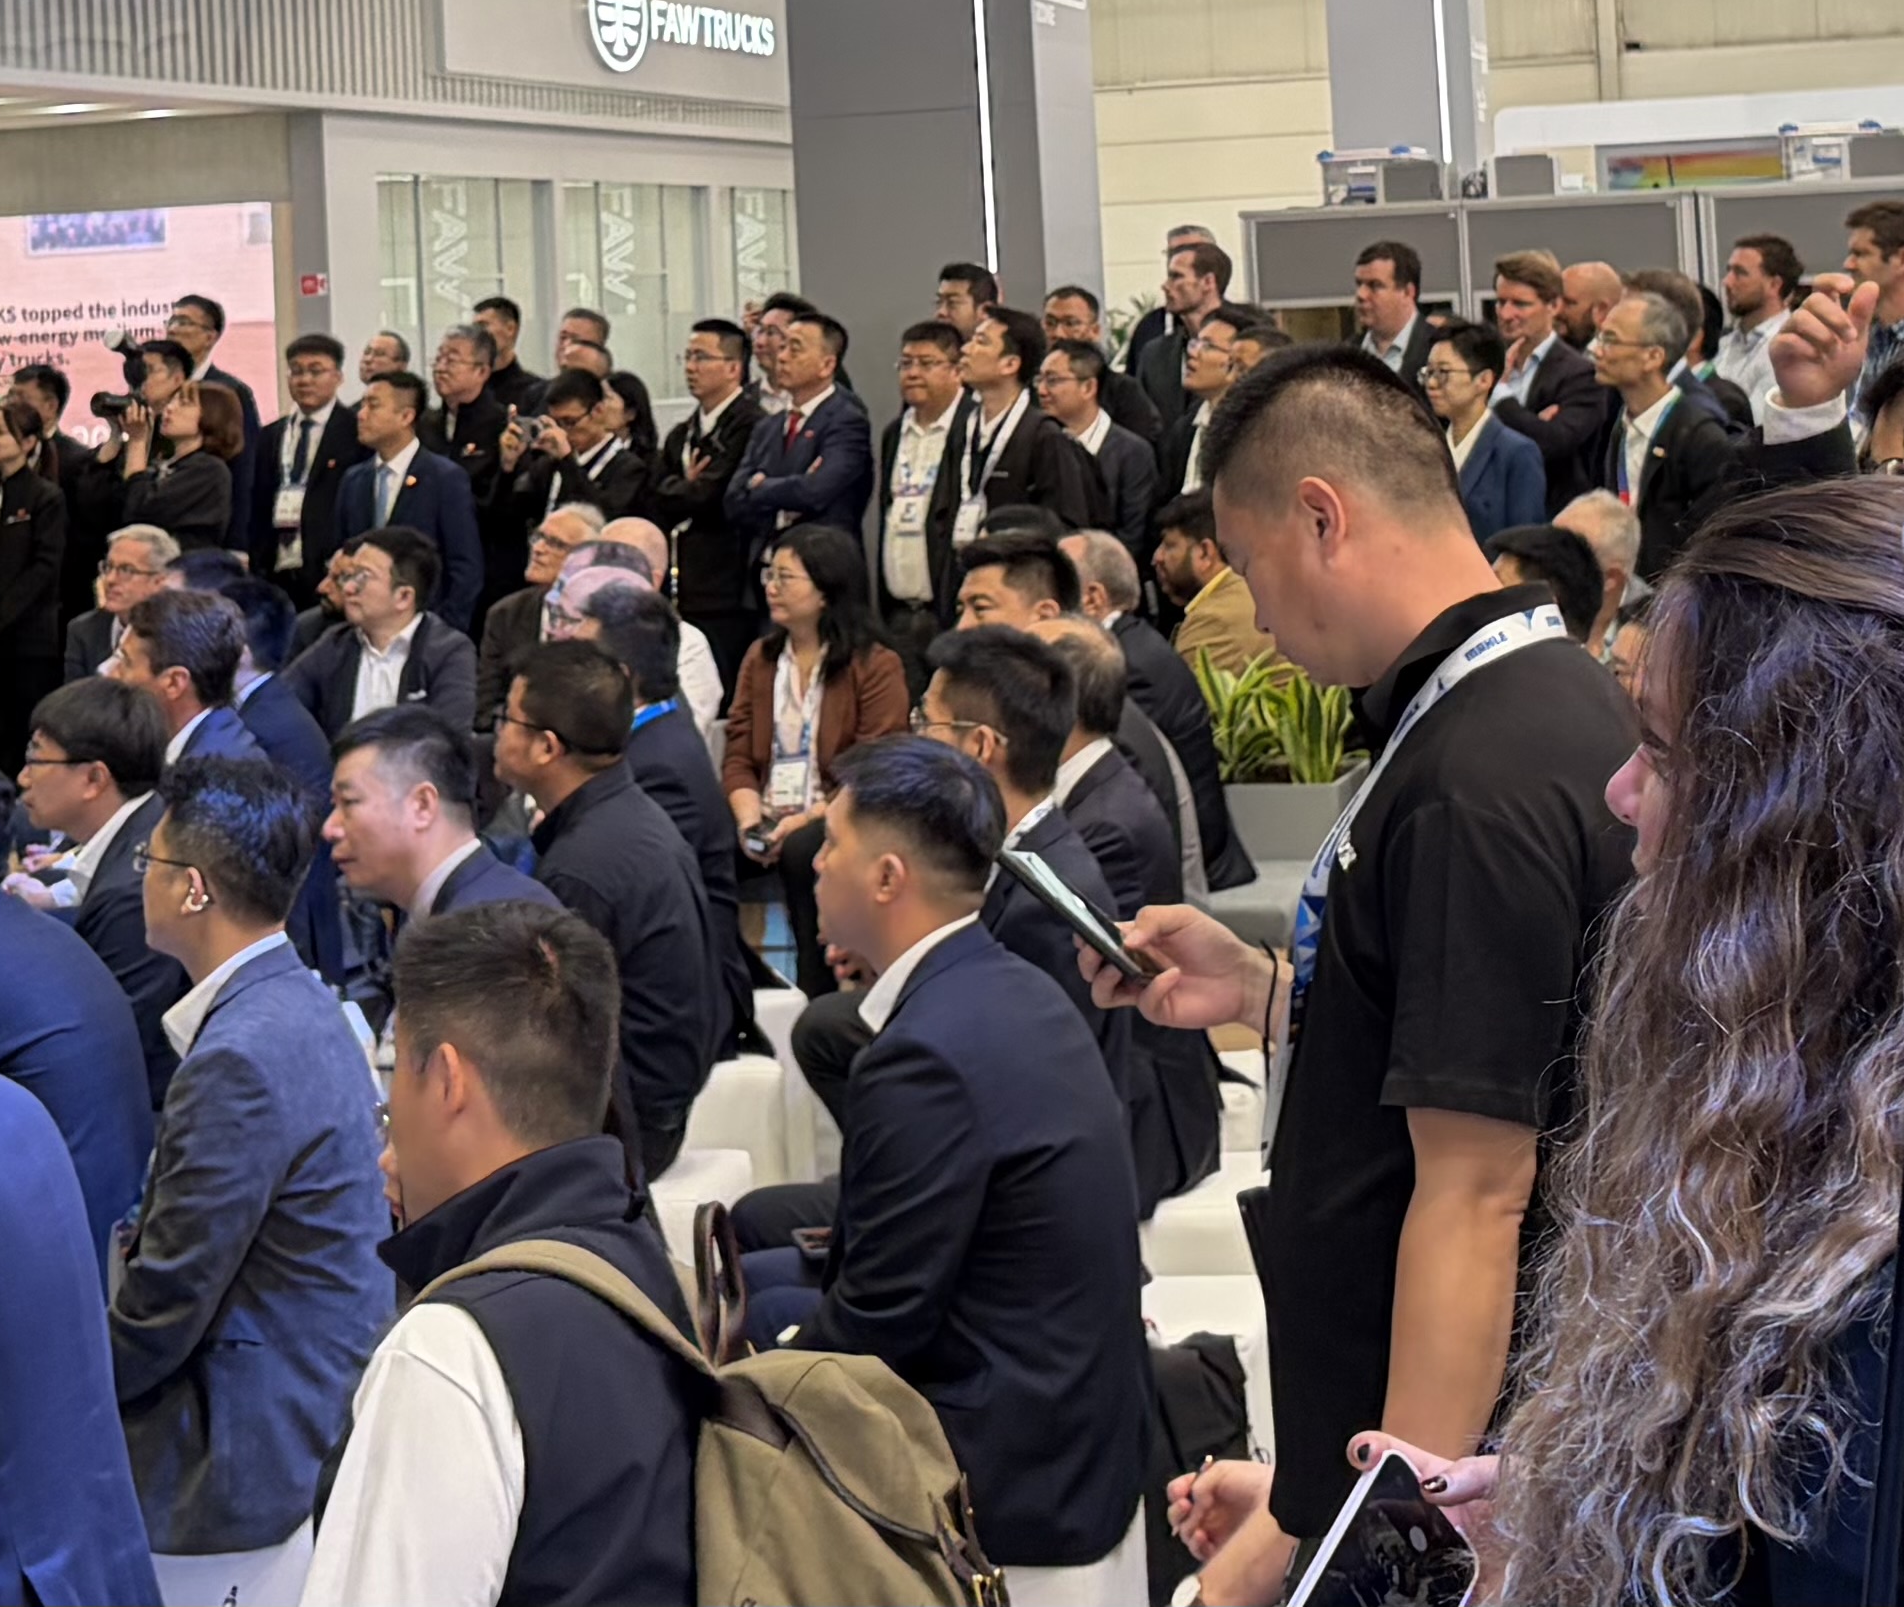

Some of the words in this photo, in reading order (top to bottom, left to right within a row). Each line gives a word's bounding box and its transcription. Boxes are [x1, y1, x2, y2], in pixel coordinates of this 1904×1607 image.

[21, 302, 84, 324] topped
[89, 301, 117, 319] the
[9, 348, 70, 366] trucks.
